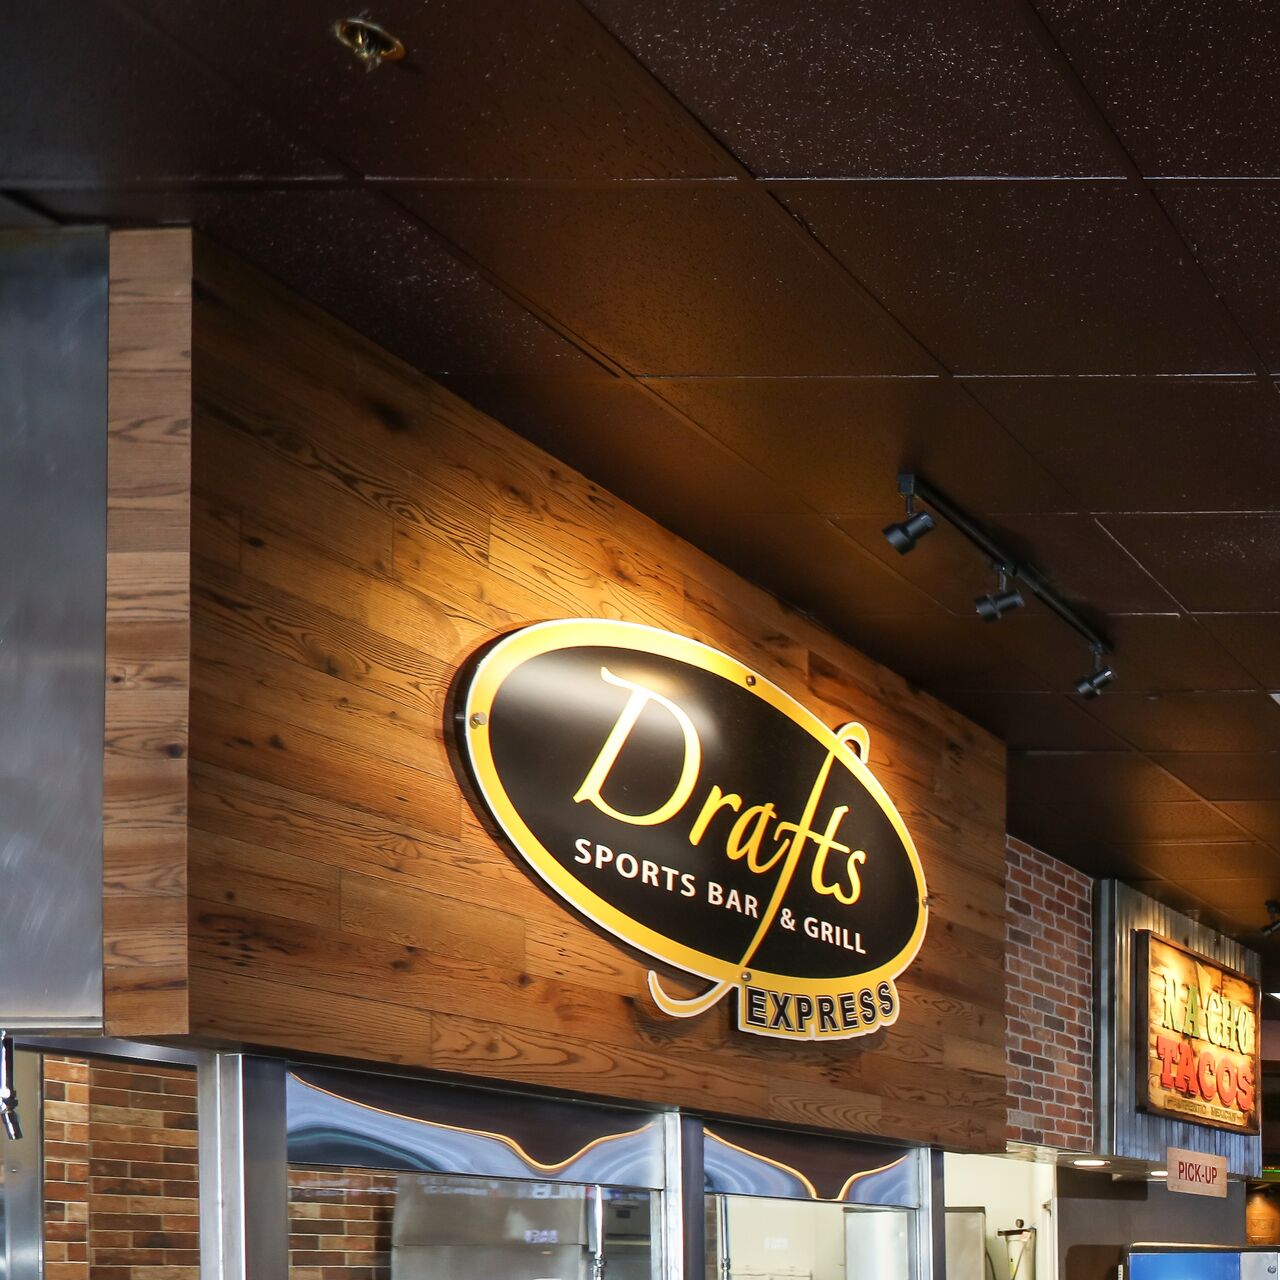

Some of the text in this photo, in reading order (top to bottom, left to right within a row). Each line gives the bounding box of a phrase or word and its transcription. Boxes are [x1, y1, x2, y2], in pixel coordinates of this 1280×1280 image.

[573, 666, 869, 1016] Drafts
[574, 838, 867, 954] SPORTS BAR & GRILL
[743, 981, 895, 1032] EXPRESS
[1161, 973, 1252, 1055] NACHO
[1156, 1035, 1254, 1112] TACOS
[1178, 1161, 1218, 1185] PICK-UP
